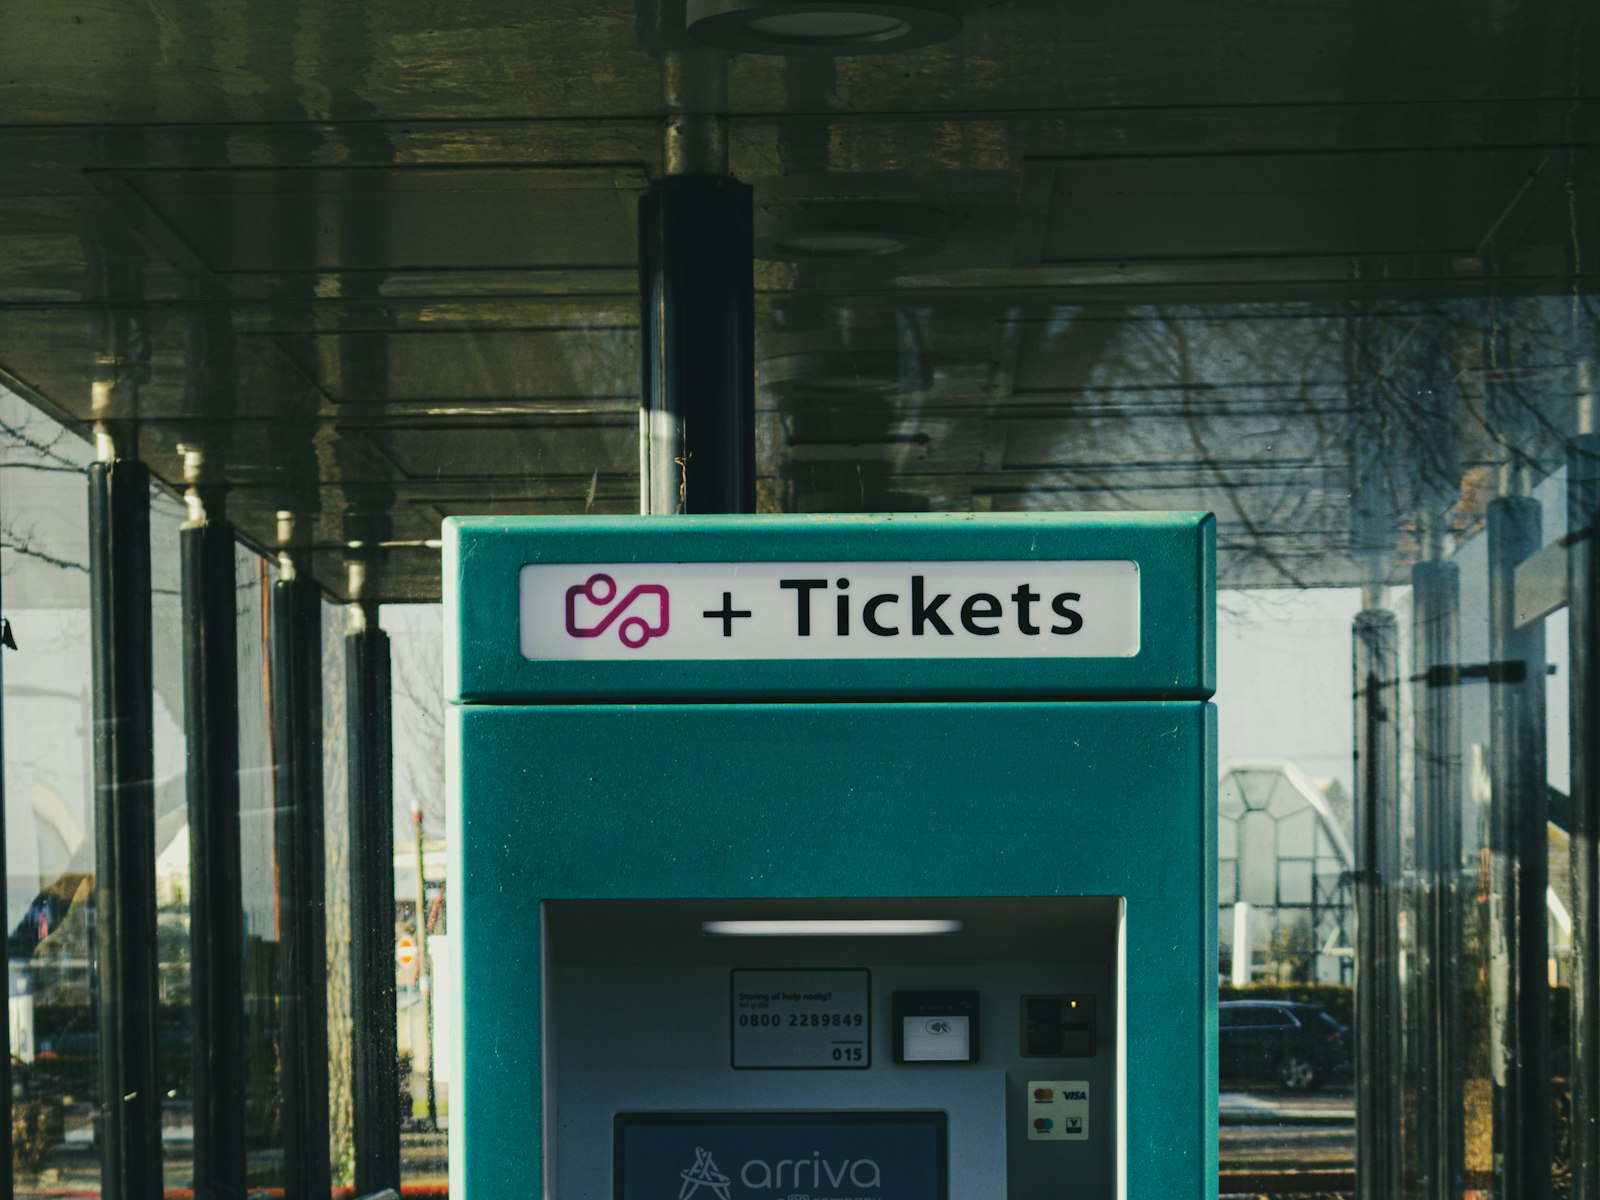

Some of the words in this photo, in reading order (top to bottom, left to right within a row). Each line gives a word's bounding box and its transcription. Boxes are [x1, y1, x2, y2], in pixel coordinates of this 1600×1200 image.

[703, 592, 752, 637] +
[779, 575, 1083, 637] Tickets
[739, 992, 770, 1002] Storing
[771, 992, 781, 1001] of
[782, 992, 801, 1002] hulp
[803, 992, 832, 1002] nodig?
[739, 1013, 781, 1027] 0800
[788, 1013, 863, 1027] 2289849
[832, 1048, 863, 1061] 015
[1062, 1091, 1087, 1100] VISA
[740, 1150, 881, 1189] arriva
